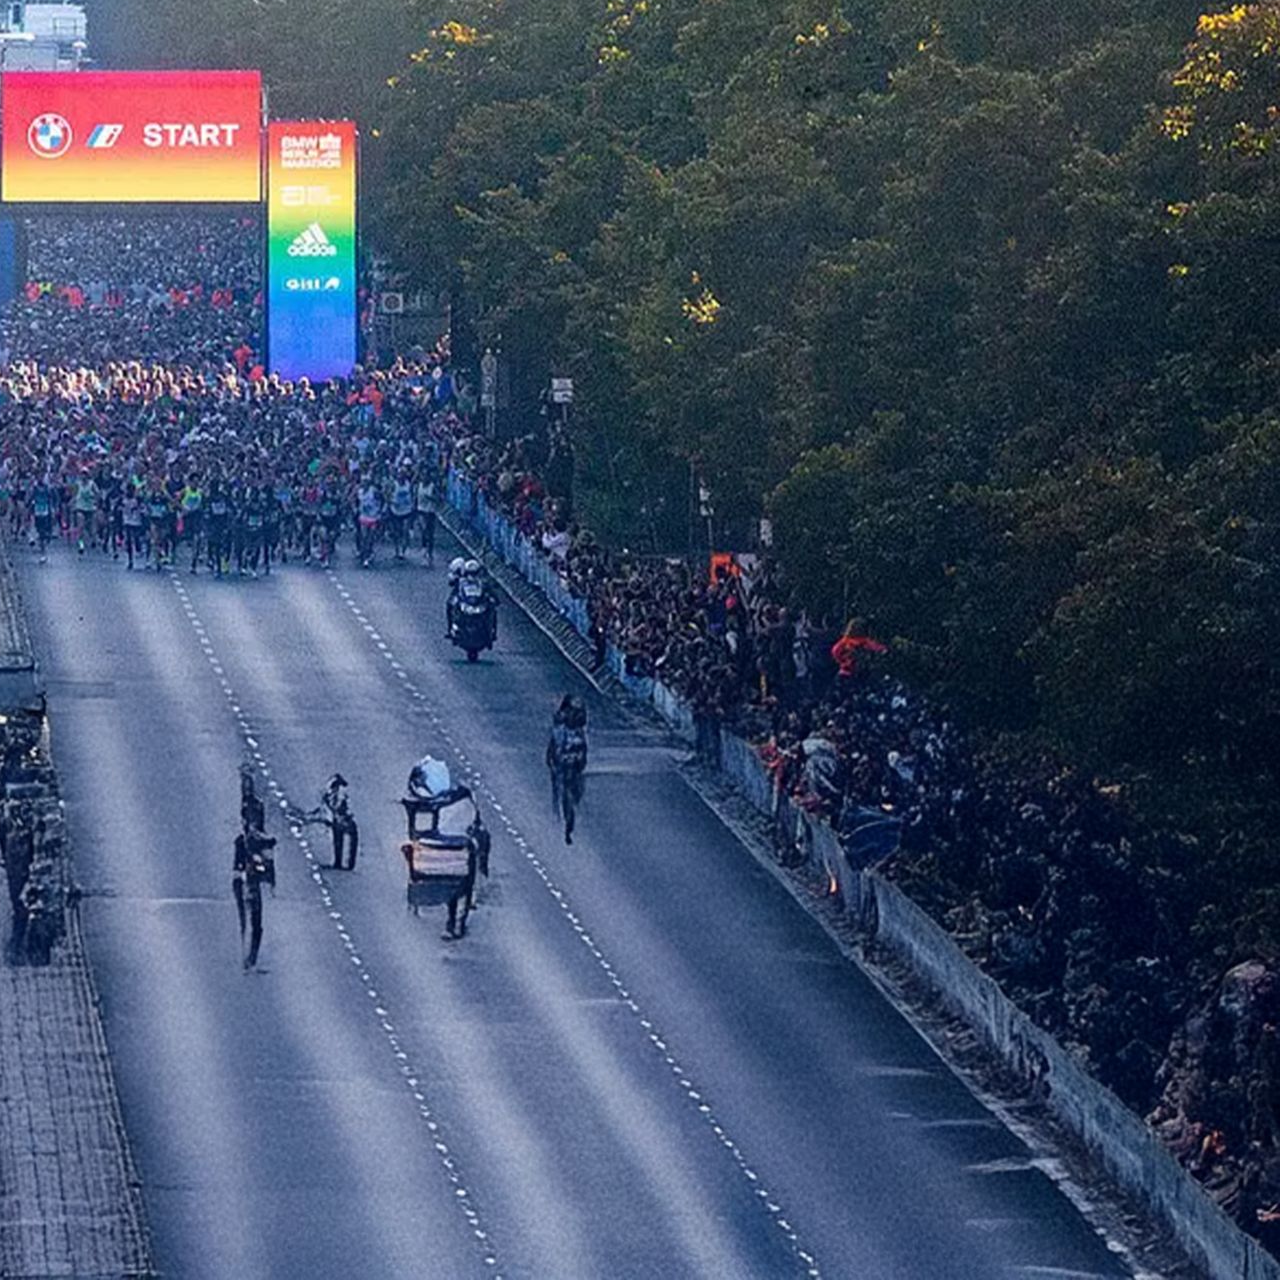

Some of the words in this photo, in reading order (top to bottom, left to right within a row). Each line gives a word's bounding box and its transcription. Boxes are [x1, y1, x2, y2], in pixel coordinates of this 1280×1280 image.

[143, 124, 240, 147] START
[281, 136, 319, 150] BMW
[281, 159, 341, 169] MARATHON
[287, 244, 337, 257] adidas
